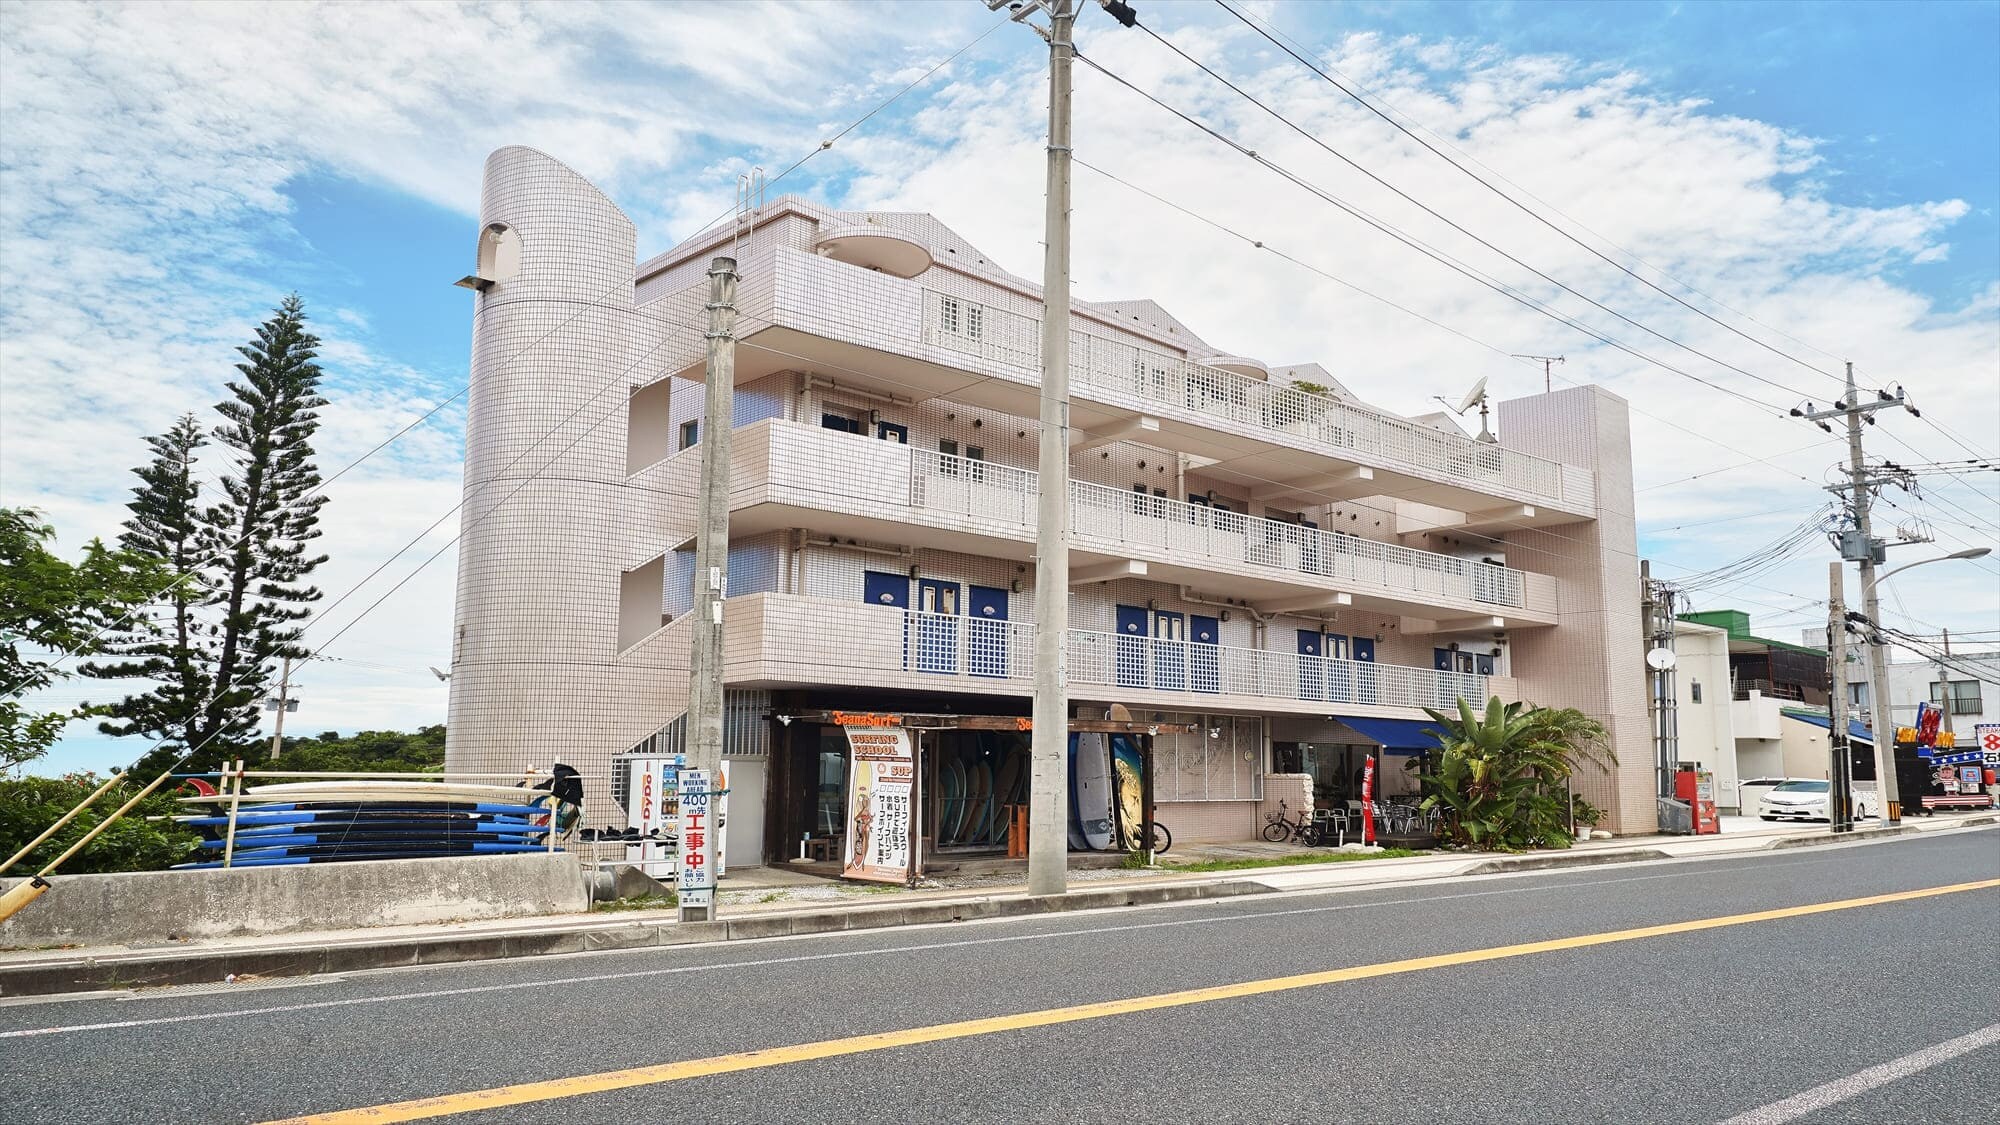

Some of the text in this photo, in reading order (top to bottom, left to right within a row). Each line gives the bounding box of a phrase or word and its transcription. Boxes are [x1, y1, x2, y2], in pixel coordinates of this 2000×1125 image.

[850, 734, 898, 744] SURFING
[854, 745, 898, 755] SCHOOL
[891, 766, 912, 776] SUP
[643, 774, 652, 820] DyDo
[683, 794, 707, 805] 400
[686, 814, 705, 869] 工事中
